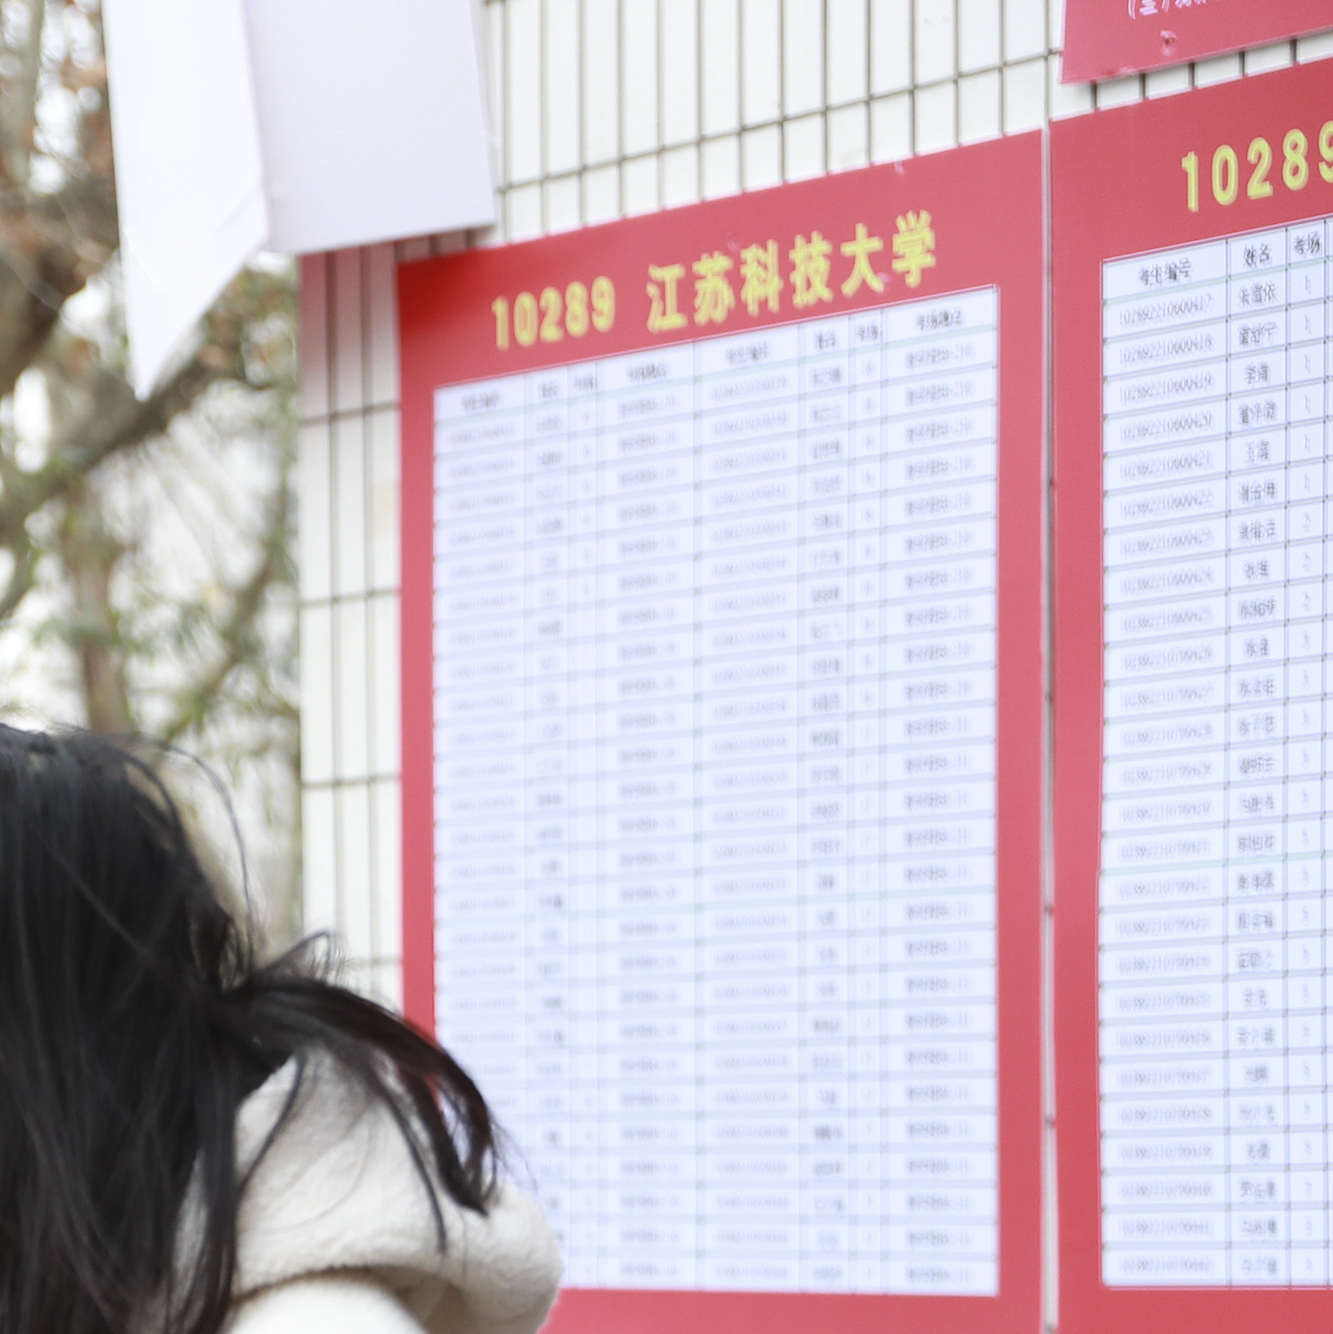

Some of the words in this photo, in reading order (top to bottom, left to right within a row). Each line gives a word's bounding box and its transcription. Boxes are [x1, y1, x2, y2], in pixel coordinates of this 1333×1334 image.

[491, 276, 616, 350] 10289
[646, 210, 937, 332] 江苏科技大学
